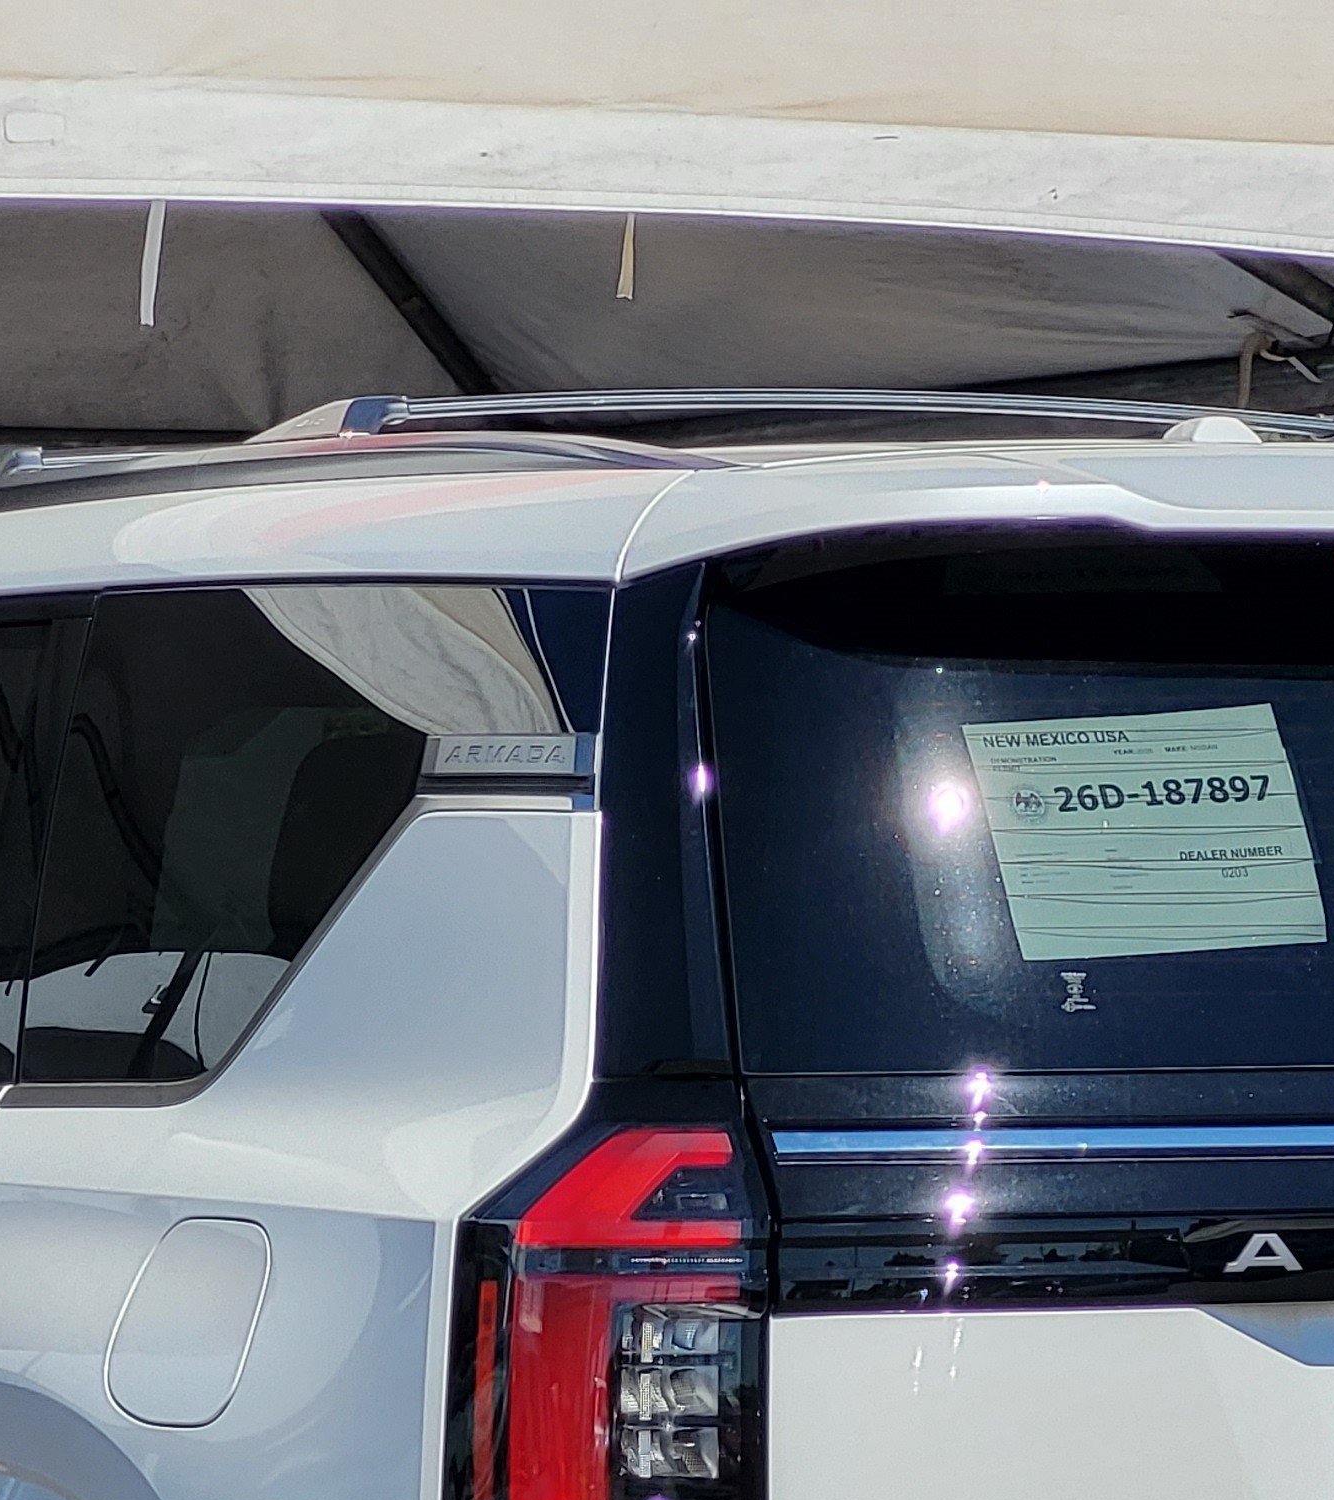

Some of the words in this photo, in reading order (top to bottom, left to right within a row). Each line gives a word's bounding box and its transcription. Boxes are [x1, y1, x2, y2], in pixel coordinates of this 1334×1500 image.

[983, 735, 1020, 748] NEW
[1025, 731, 1090, 747] MEXICO
[1094, 730, 1130, 744] USA
[444, 744, 566, 764] ARMADA
[1054, 775, 1270, 813] 26D-187897
[1179, 849, 1228, 861] DEALER
[1230, 845, 1283, 858] NUMBER
